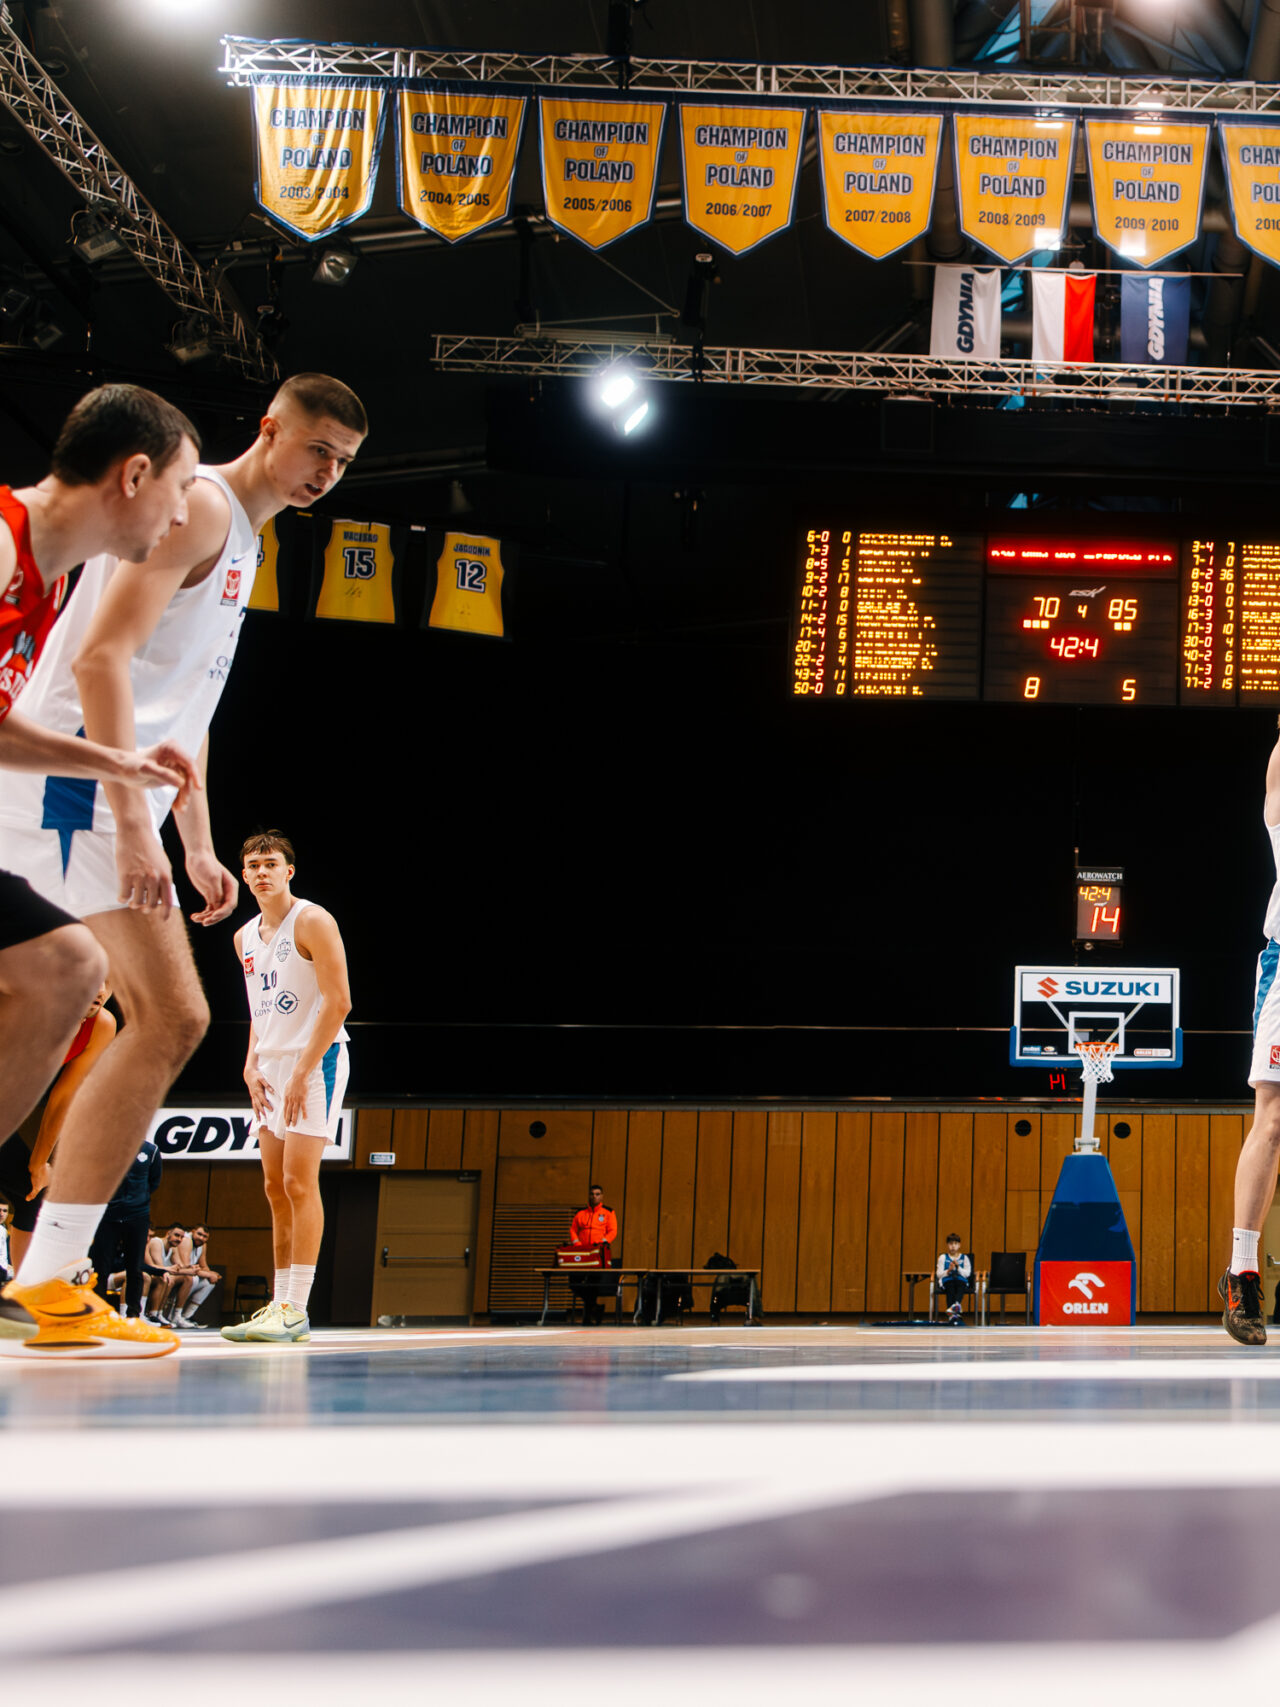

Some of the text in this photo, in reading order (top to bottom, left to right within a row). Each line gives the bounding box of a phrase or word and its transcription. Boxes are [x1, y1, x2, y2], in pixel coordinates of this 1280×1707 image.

[271, 108, 366, 131] CHAMPION
[411, 114, 507, 138] CHAMPION
[311, 132, 325, 145] OF
[555, 120, 649, 145] CHAMPION
[695, 126, 788, 149] CHAMPION
[452, 139, 466, 151] OF
[834, 132, 926, 157] CHAMPION
[969, 135, 1059, 160] CHAMPION
[280, 147, 352, 169] POLAND
[594, 146, 608, 158] OF
[735, 151, 748, 163] OF
[1102, 141, 1193, 165] CHAMPION
[421, 153, 493, 177] POLAND
[564, 159, 634, 183] POLAND
[873, 158, 887, 171] OF
[1007, 161, 1020, 173] OF
[705, 164, 774, 189] POLAND
[1141, 166, 1154, 179] OF
[844, 172, 913, 194] POLAND
[979, 175, 1047, 198] POLAND
[280, 186, 349, 199] 2003/2004
[420, 190, 490, 206] 2004/2005
[1113, 180, 1181, 204] POLAND
[563, 198, 632, 212] 2005/2006
[706, 203, 771, 217] 2006/2007
[845, 210, 911, 223] 2007/2008
[978, 211, 1045, 226] 2008/2009
[1115, 217, 1179, 231] 2009/2010
[957, 273, 975, 354] GDYNIA
[1148, 278, 1165, 361] GDYNIA
[842, 531, 852, 544] 0
[1227, 542, 1236, 554] 7
[343, 548, 376, 579] 15
[841, 558, 850, 571] 5
[1225, 555, 1235, 568] 0
[455, 559, 487, 593] 12
[837, 572, 850, 584] 17
[1219, 569, 1235, 581] 36
[840, 586, 850, 598] 8
[1225, 582, 1235, 595] 0
[839, 599, 849, 612] 0
[1033, 597, 1061, 619] 70
[1225, 595, 1235, 608] 0
[1077, 604, 1088, 619] 4
[1107, 599, 1138, 620] 85
[1226, 609, 1235, 621] 7
[836, 613, 848, 626] 15
[838, 627, 847, 640] 6
[1222, 623, 1235, 635] 10
[838, 641, 848, 654] 3
[1050, 636, 1100, 659] 42:4
[1225, 636, 1234, 648] 4
[838, 655, 847, 667] 4
[1224, 650, 1234, 663] 6
[833, 669, 847, 680] 11
[1224, 664, 1234, 676] 0
[836, 682, 846, 695] 0
[1023, 677, 1041, 698] 8
[1121, 679, 1137, 701] 5
[1221, 677, 1234, 690] 15
[1080, 886, 1111, 901] 42:4
[1091, 907, 1120, 933] 14
[261, 969, 278, 991] 10
[1065, 981, 1159, 997] SUZUKI
[1062, 1303, 1109, 1315] ORLEN
